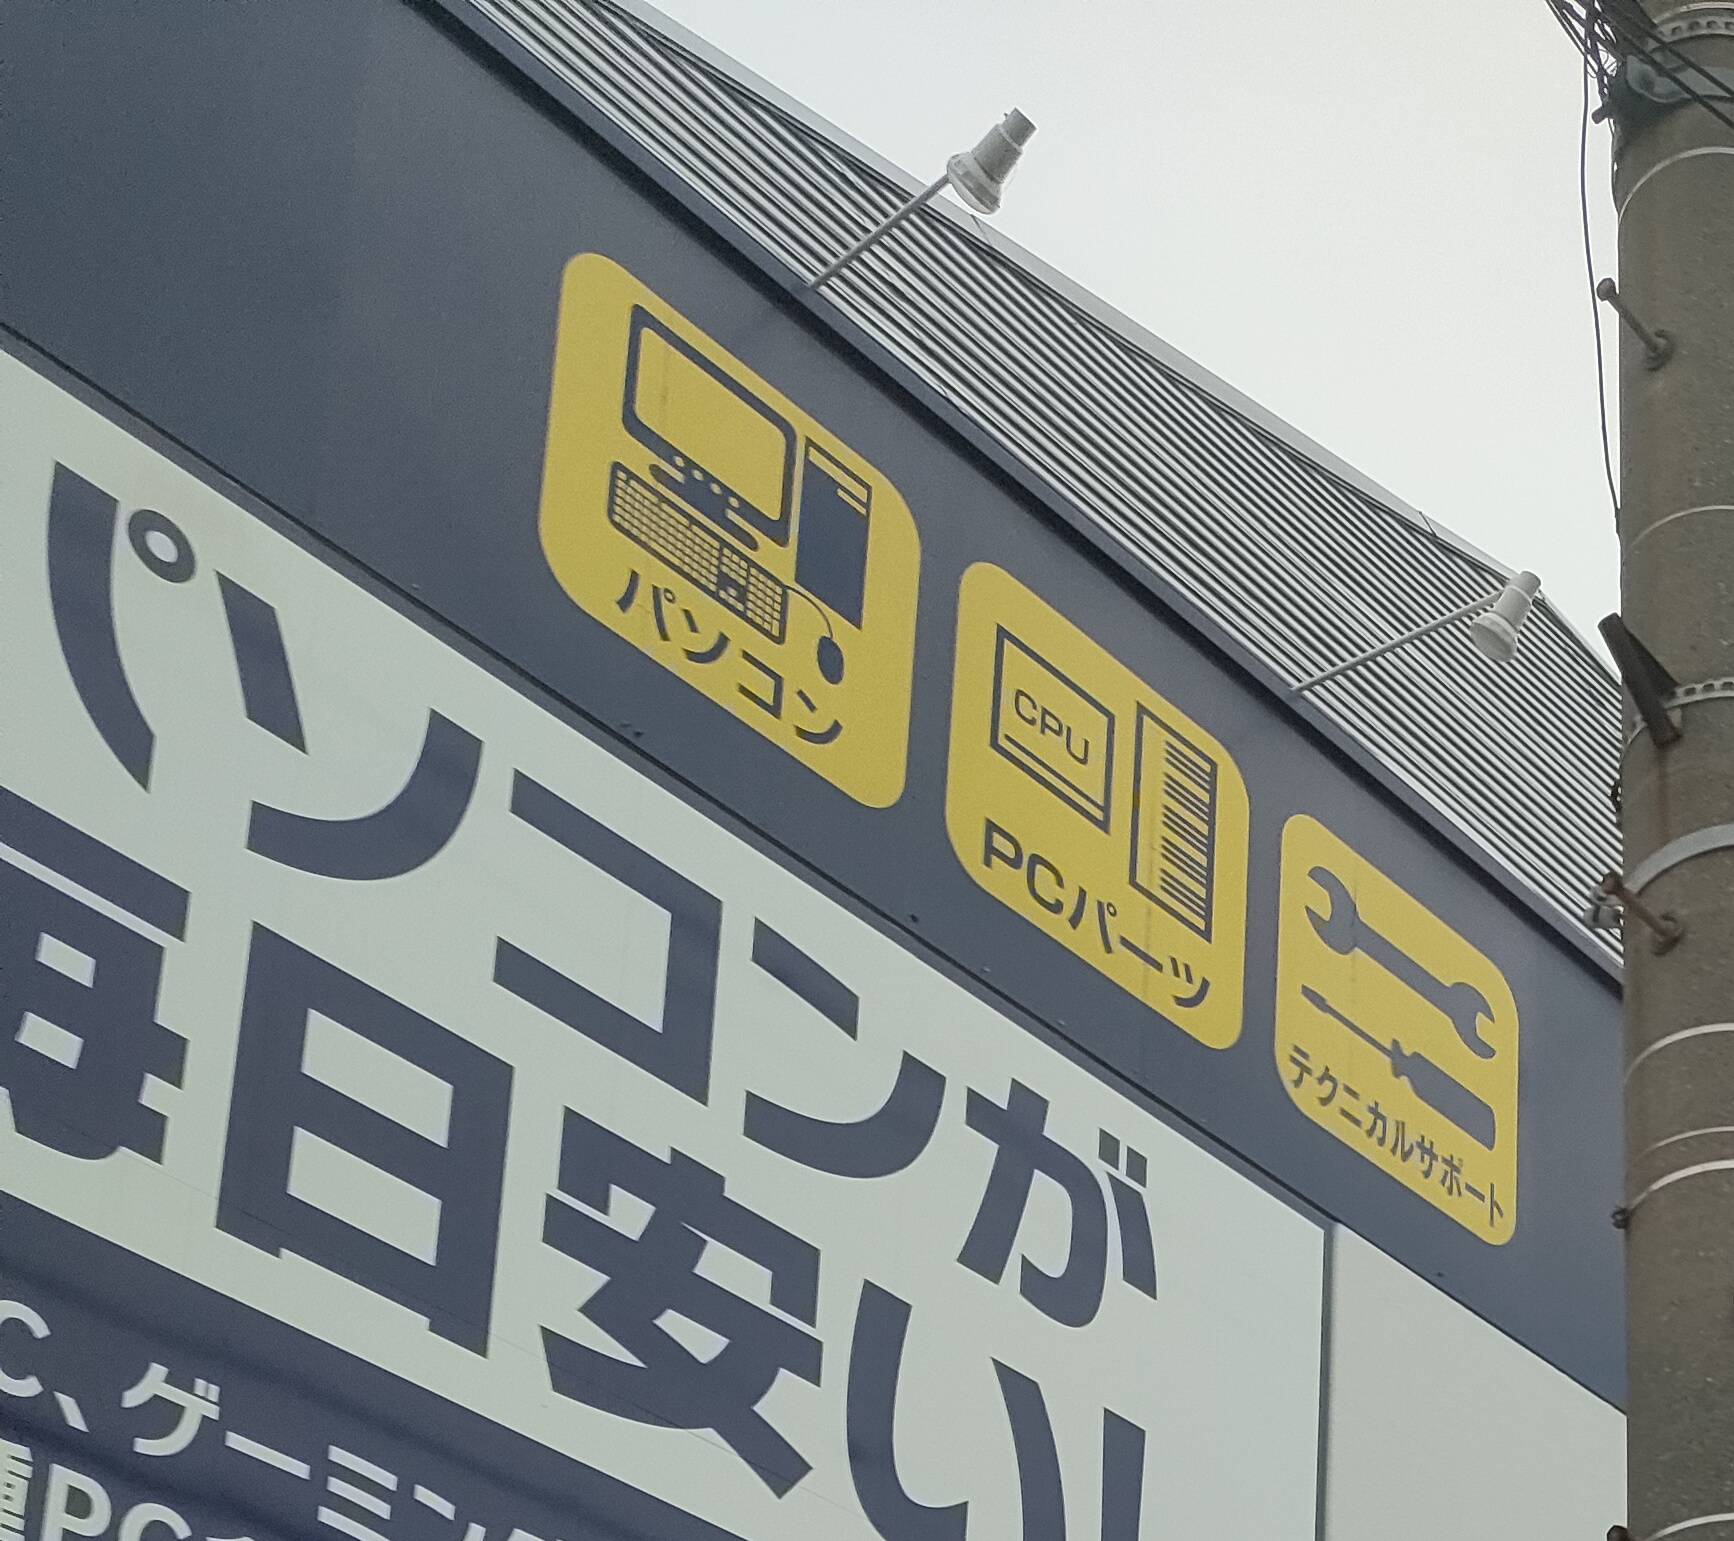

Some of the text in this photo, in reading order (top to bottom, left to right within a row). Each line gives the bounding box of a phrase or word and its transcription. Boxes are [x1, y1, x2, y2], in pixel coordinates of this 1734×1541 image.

[617, 568, 842, 745] パソコン
[1013, 687, 1090, 767] CPU
[46, 460, 1158, 1329] パソコンが
[981, 820, 1211, 1008] PCパーツ
[1287, 1045, 1505, 1227] テクニカルサポート
